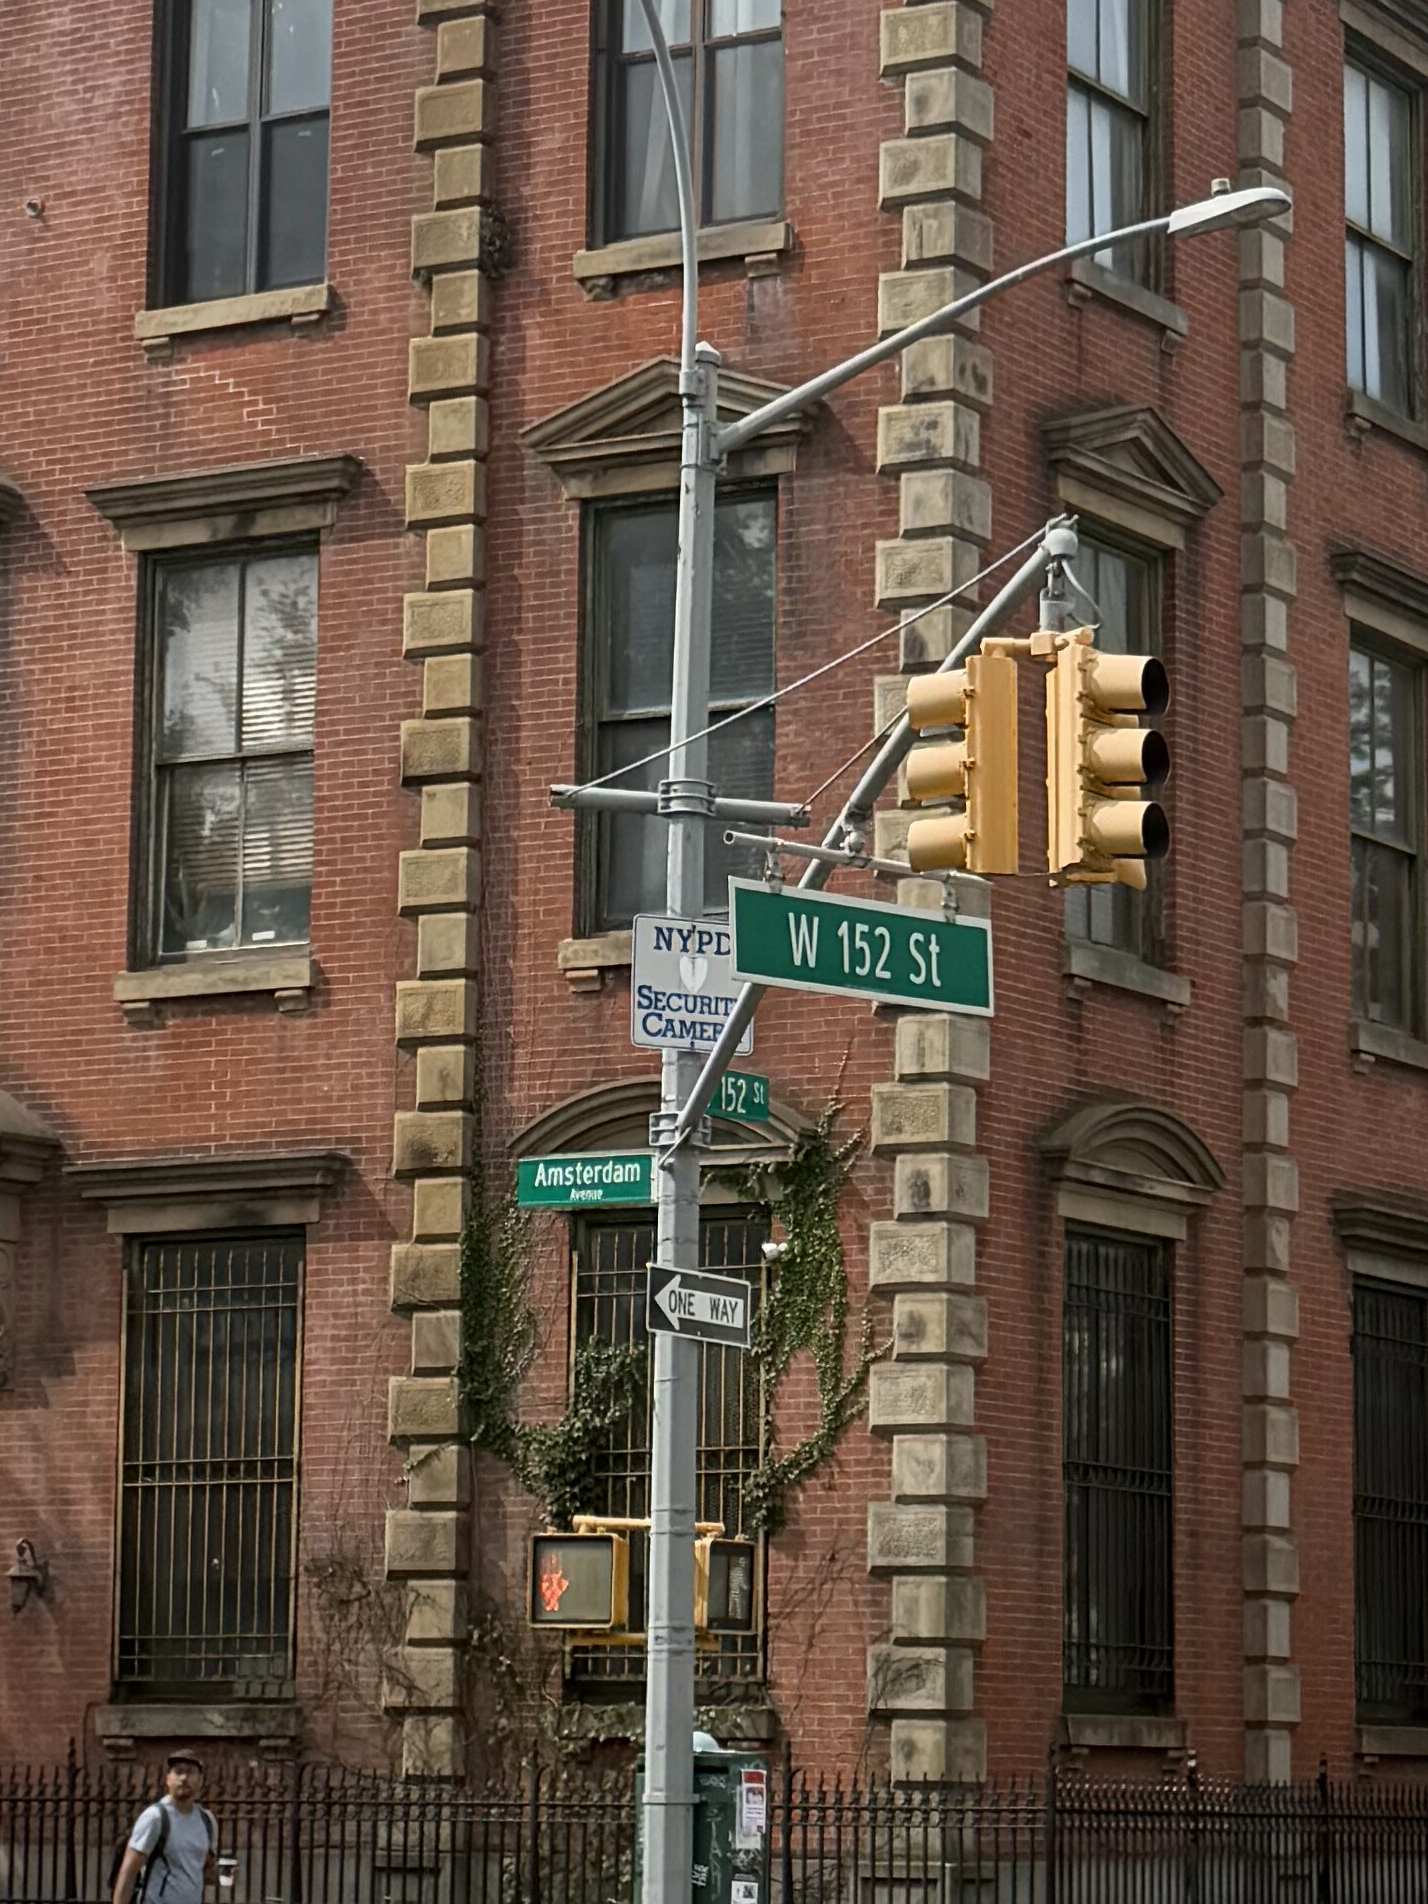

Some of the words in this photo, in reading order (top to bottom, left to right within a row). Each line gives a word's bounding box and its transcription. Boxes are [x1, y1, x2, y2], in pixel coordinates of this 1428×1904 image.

[653, 925, 731, 956] NYPD
[788, 912, 819, 968] W
[837, 921, 892, 979] 152
[909, 932, 942, 987] St
[637, 984, 738, 1017] SECURIT
[642, 1012, 725, 1042] CAMER
[721, 1075, 746, 1113] 152
[534, 1160, 640, 1187] Amsterdam
[569, 1188, 603, 1201] Avenue
[668, 1289, 695, 1316] ONE
[709, 1297, 738, 1324] WAY
